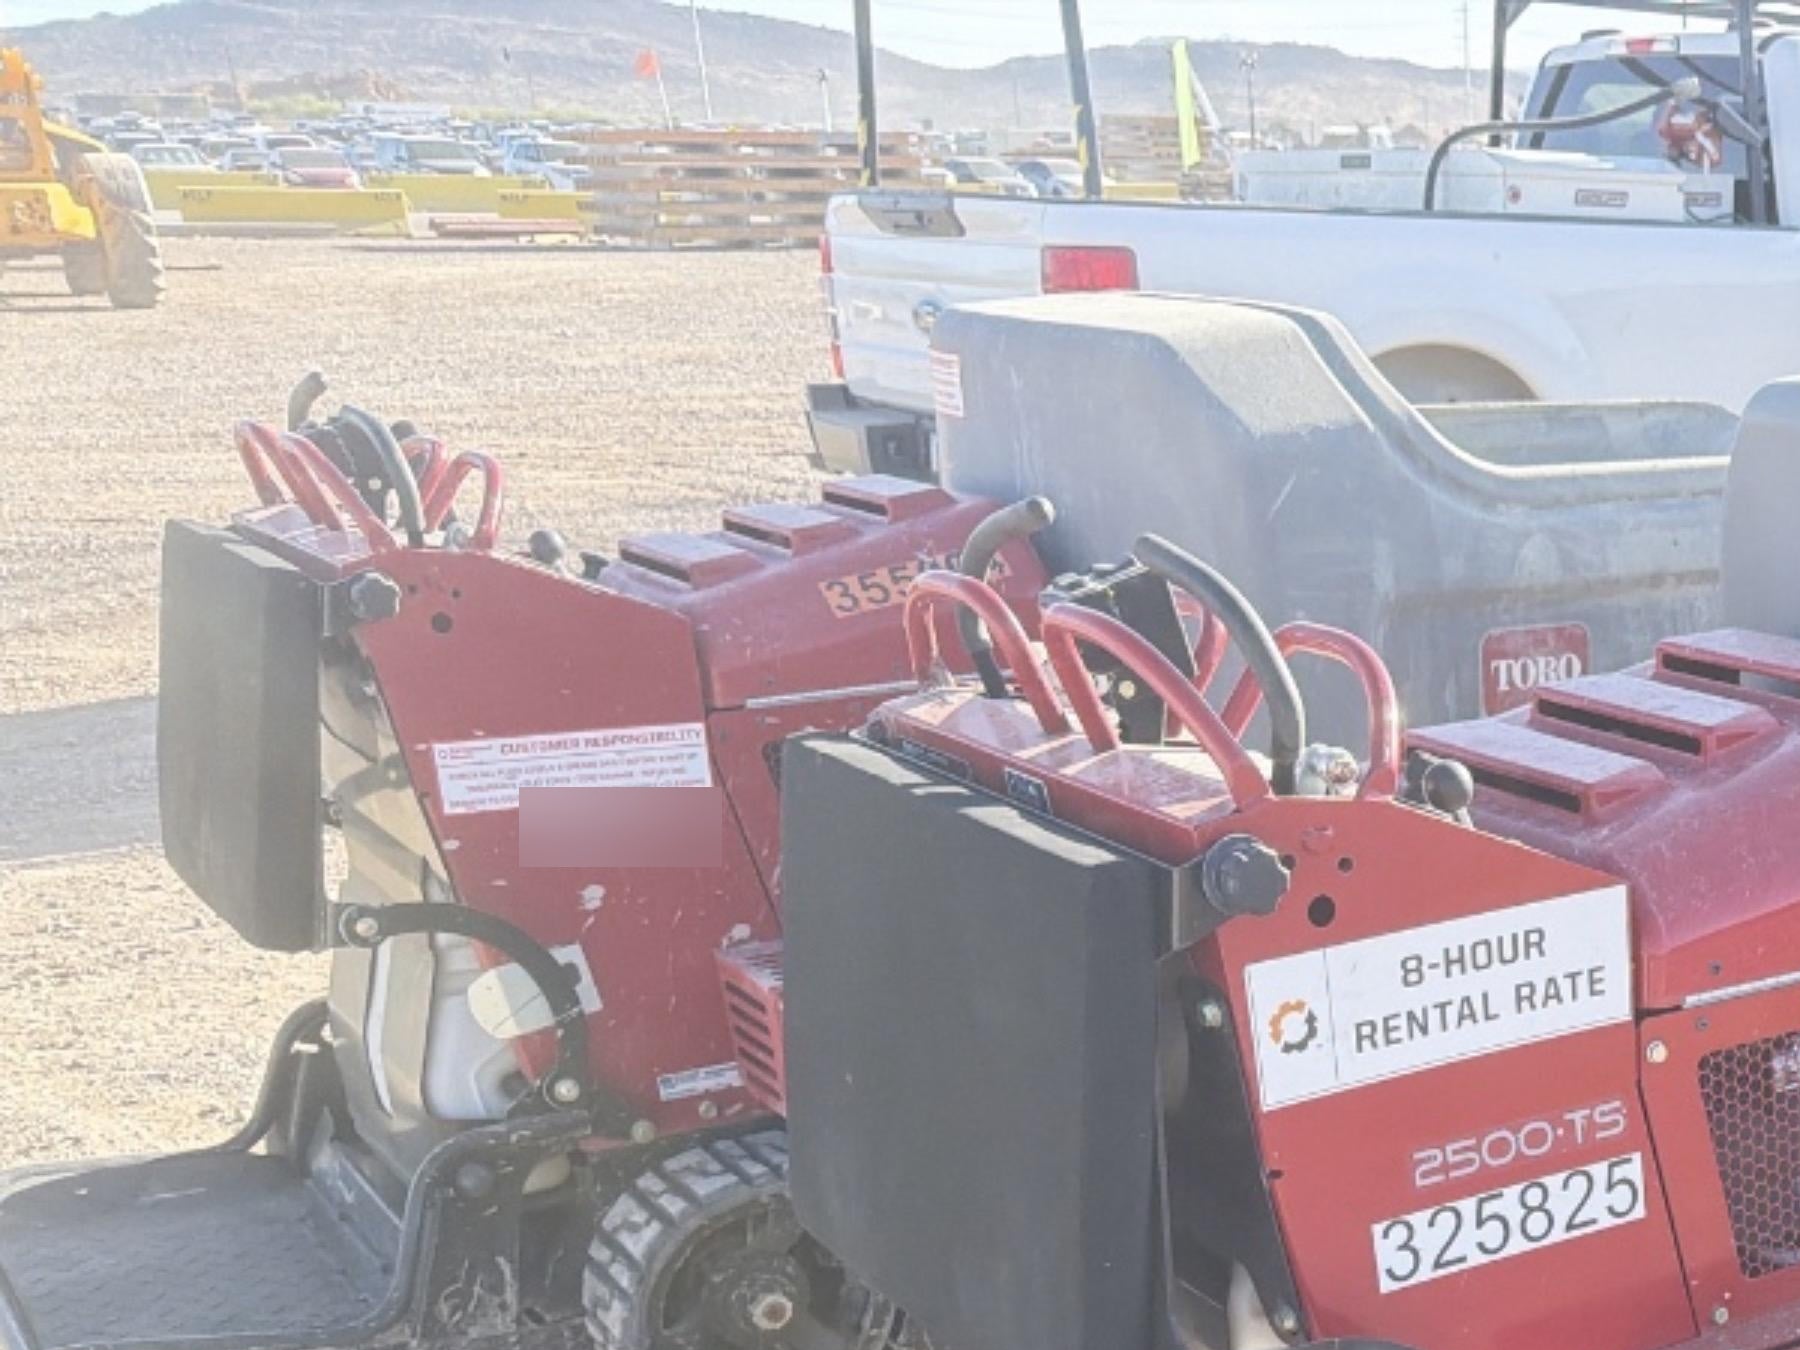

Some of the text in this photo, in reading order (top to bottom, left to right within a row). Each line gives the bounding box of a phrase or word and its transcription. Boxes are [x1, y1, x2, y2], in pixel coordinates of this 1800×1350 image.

[1490, 653, 1582, 692] TORO
[1400, 926, 1547, 988] 8-HOUR
[1354, 965, 1606, 1054] RENTAL RATE
[1382, 1157, 1639, 1283] 325825
